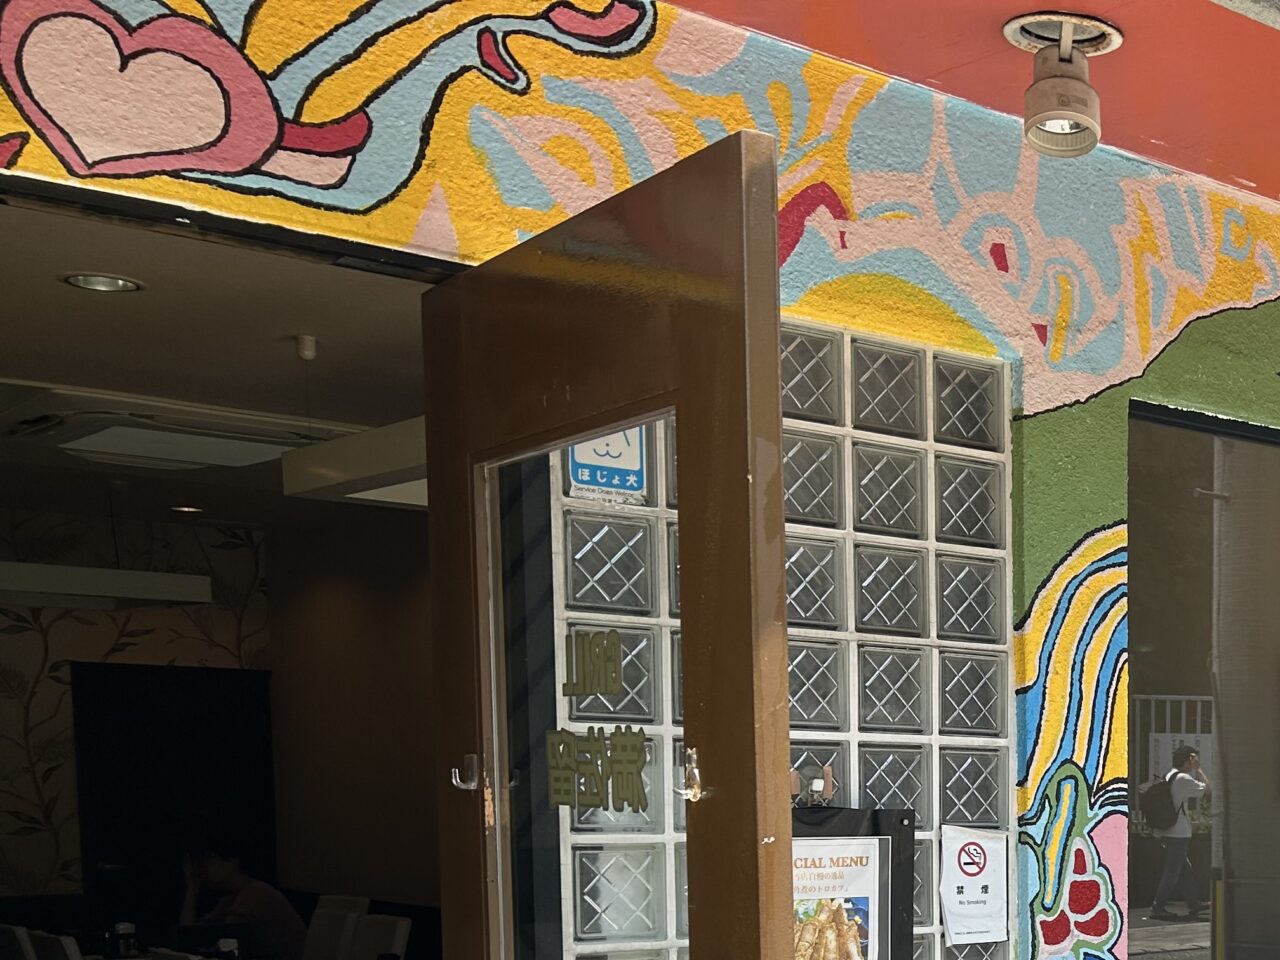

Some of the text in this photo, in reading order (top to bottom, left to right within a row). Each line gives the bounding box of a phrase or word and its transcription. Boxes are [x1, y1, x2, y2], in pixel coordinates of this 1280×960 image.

[577, 467, 638, 488] ほじょ犬
[794, 856, 870, 869] CIAL MENU
